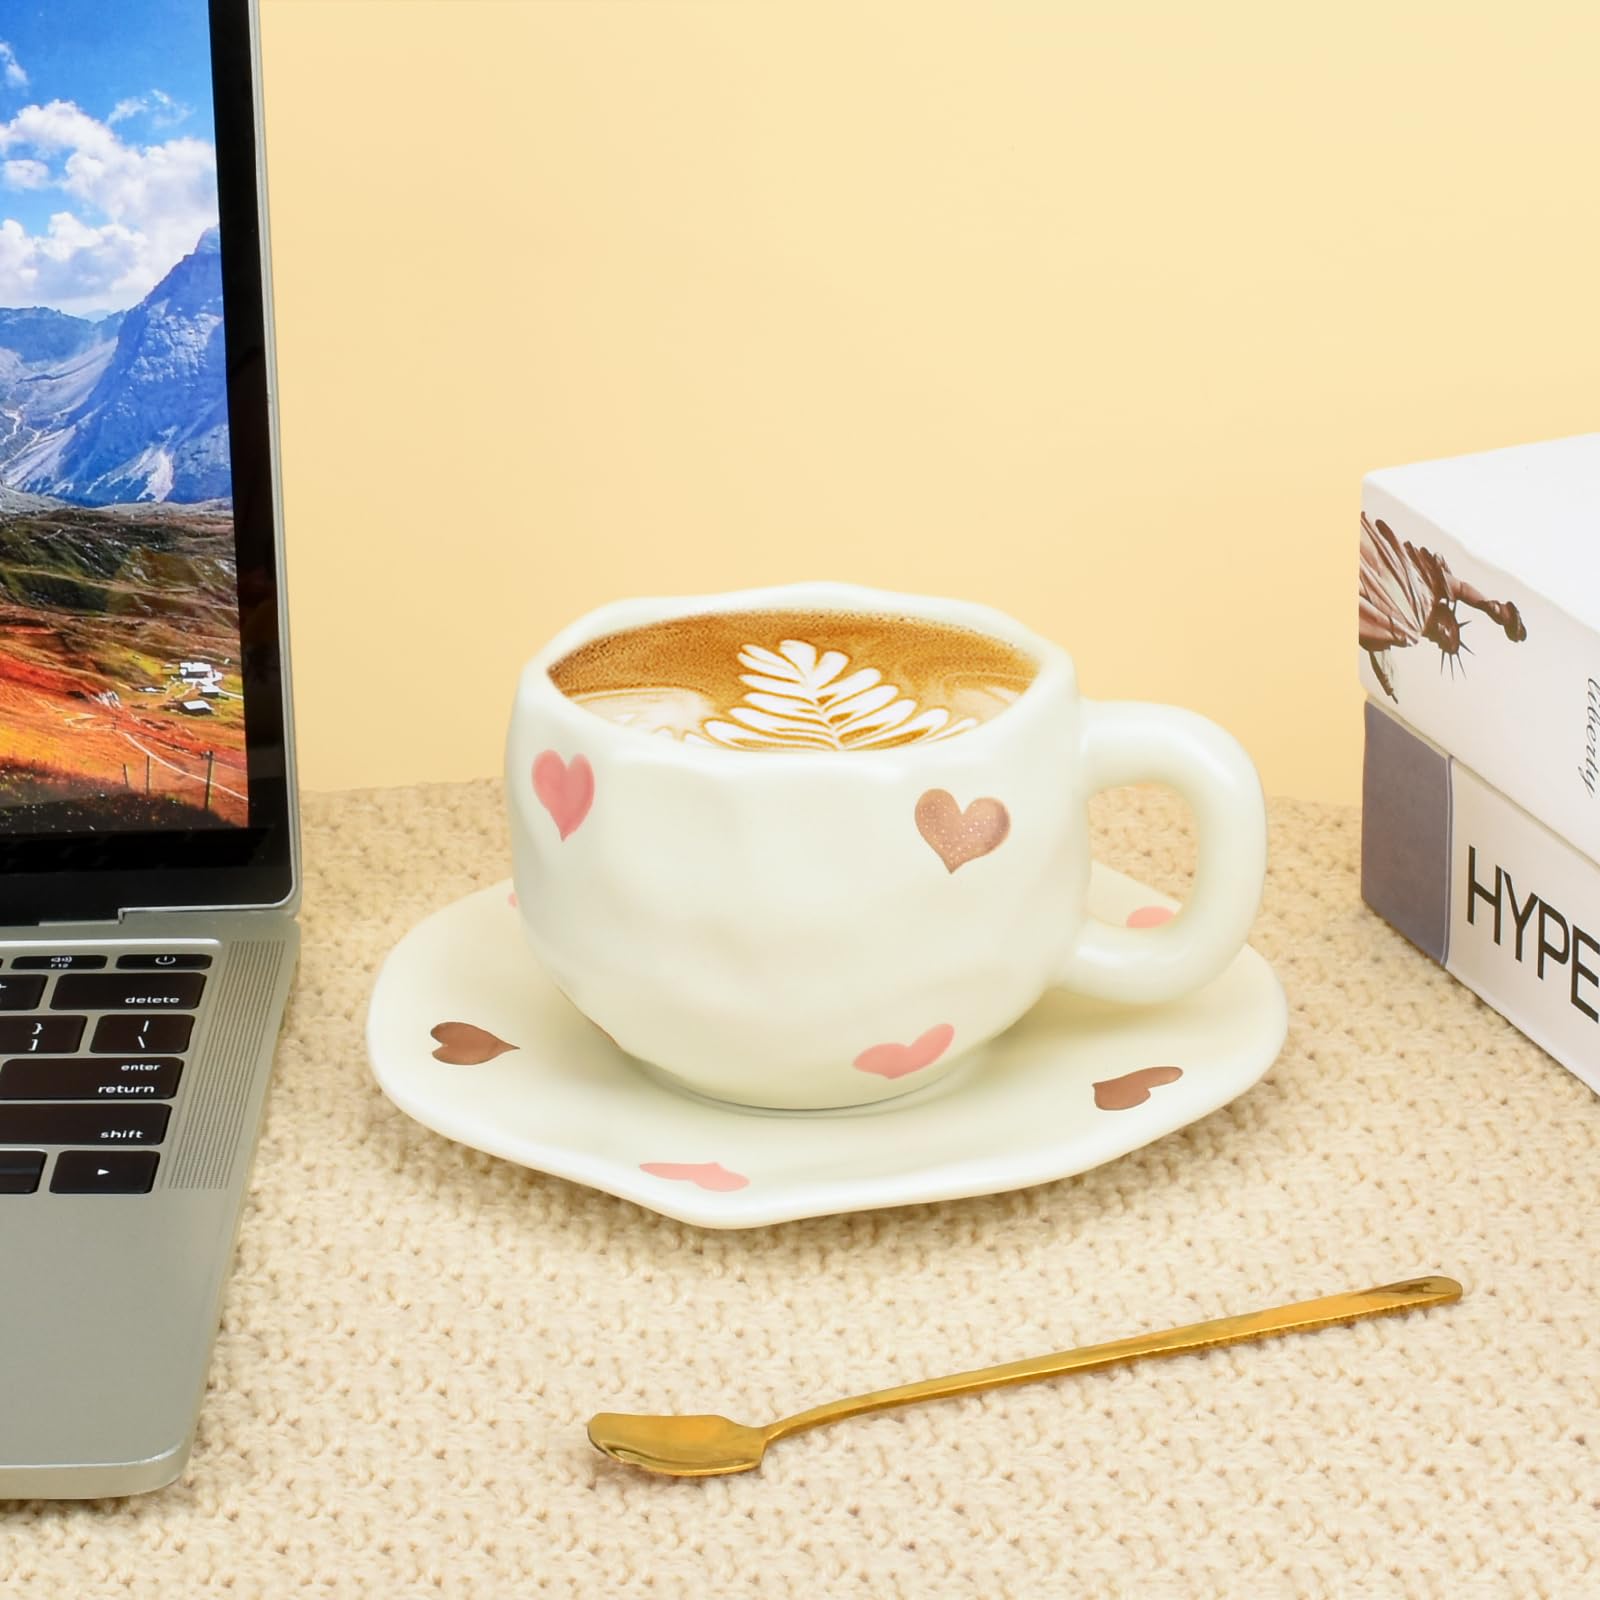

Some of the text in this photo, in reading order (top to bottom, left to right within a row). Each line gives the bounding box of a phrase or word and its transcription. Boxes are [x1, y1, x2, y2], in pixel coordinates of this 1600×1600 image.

[1467, 844, 1600, 1023] HYPE
[124, 996, 180, 1004] delete
[32, 1022, 43, 1034] }
[29, 1038, 39, 1052] ]
[120, 1063, 161, 1072] enter
[97, 1084, 156, 1094] return
[100, 1129, 144, 1139] shift
